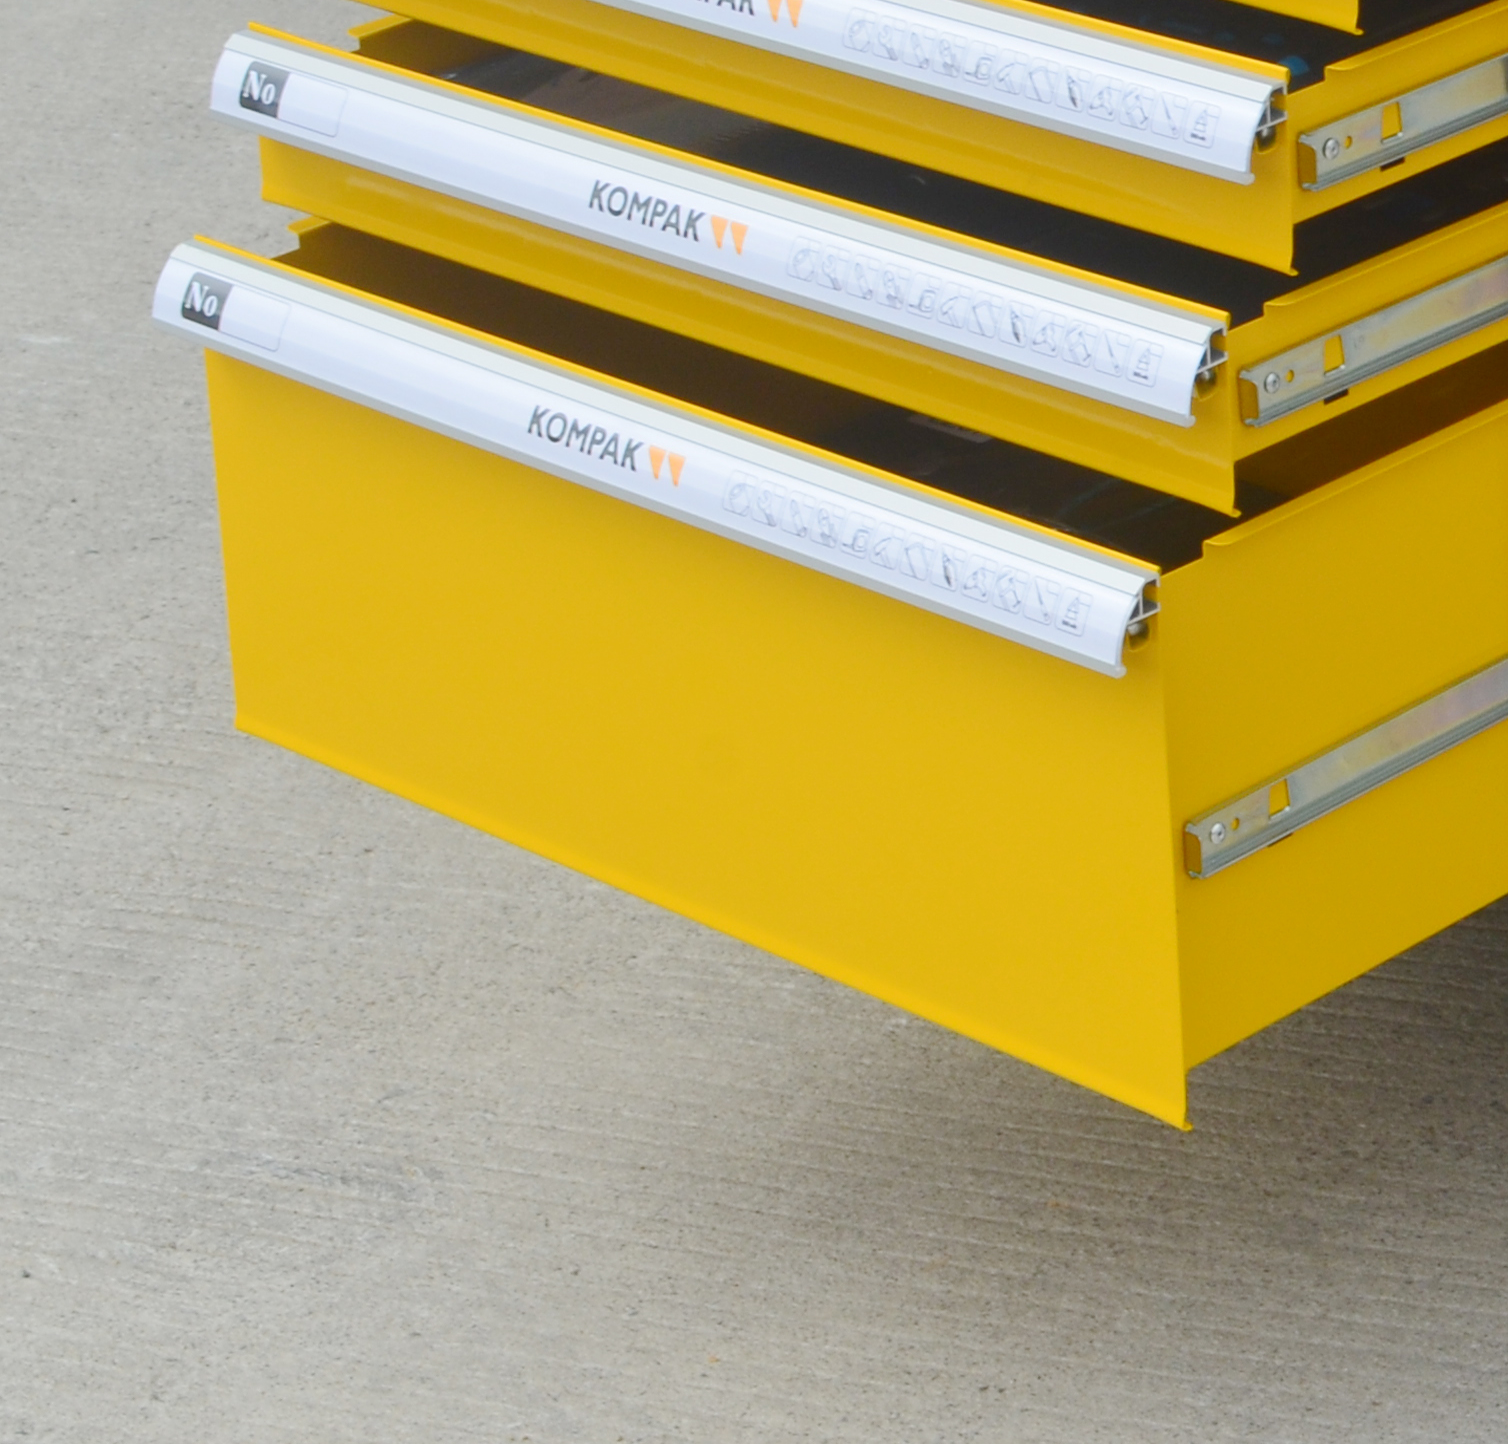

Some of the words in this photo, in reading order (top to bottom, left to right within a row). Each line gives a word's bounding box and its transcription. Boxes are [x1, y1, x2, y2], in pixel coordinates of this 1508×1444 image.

[242, 70, 276, 105] No
[588, 179, 706, 242] KOMPAK
[183, 280, 218, 318] No
[528, 405, 645, 472] KOMPAK
